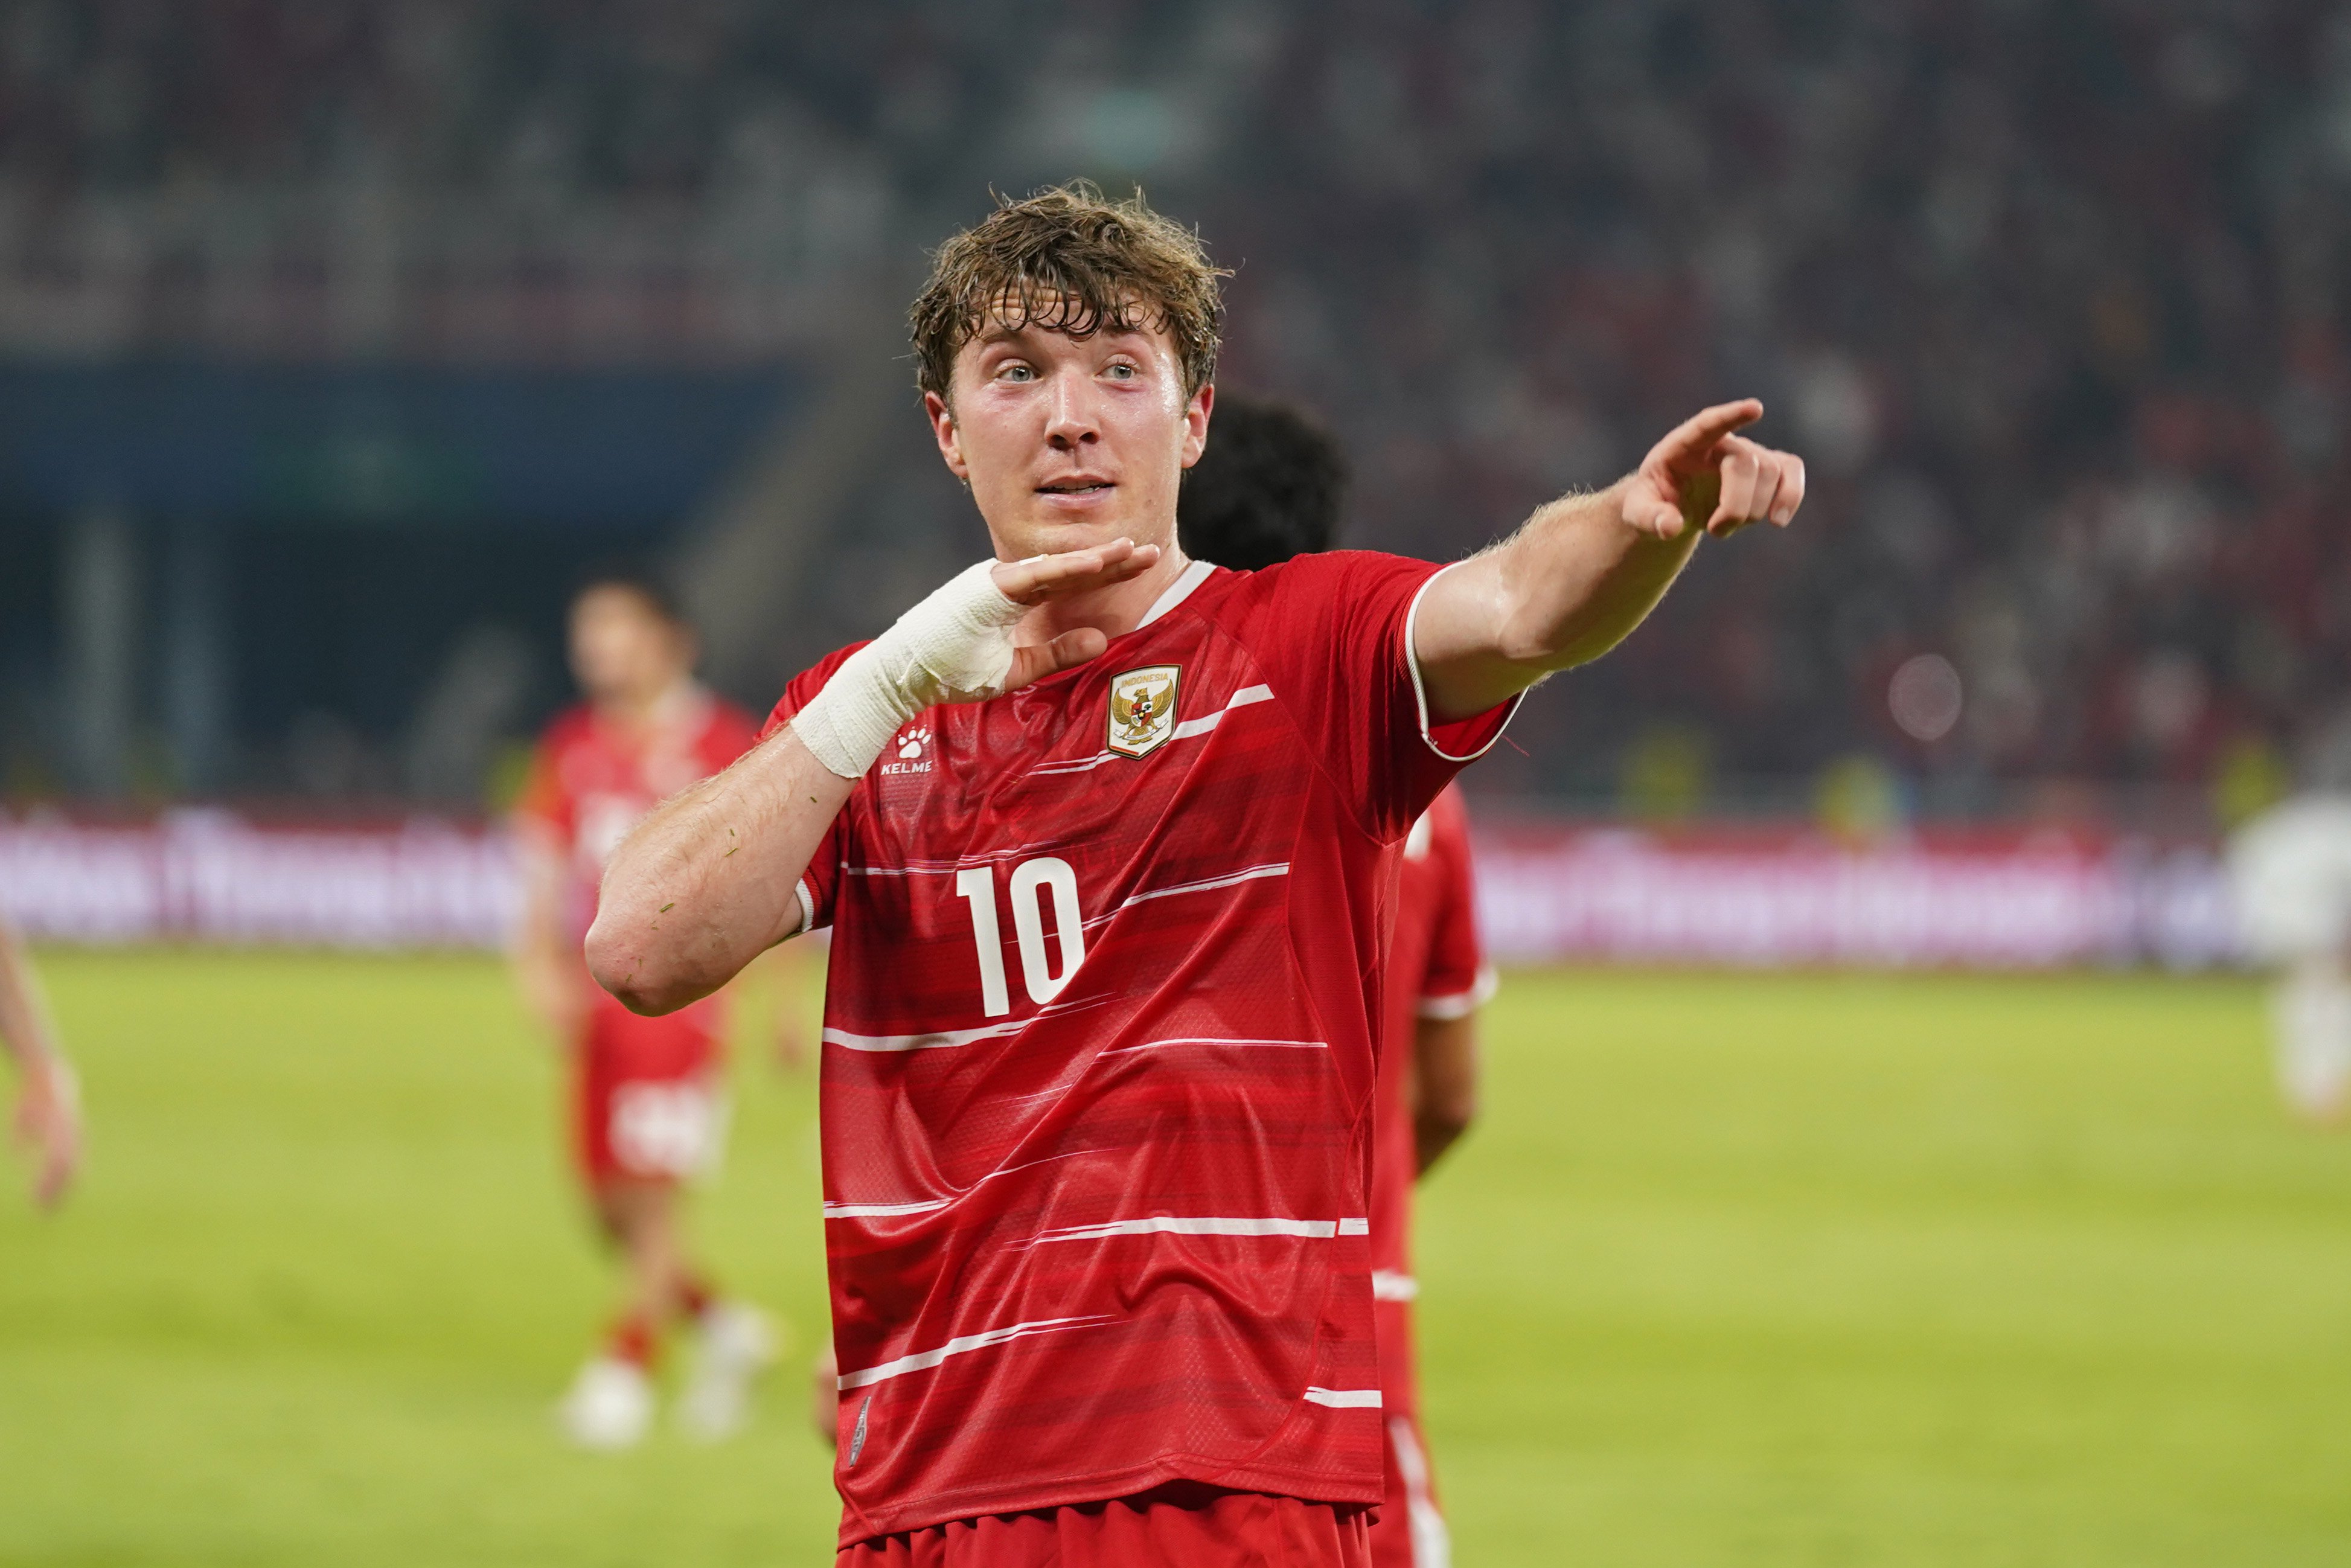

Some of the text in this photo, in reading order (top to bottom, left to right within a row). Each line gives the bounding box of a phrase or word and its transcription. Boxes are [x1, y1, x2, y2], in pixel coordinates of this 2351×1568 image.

[1121, 673, 1169, 688] INDONESIA
[880, 760, 933, 776] KELME
[956, 857, 1086, 1017] 10
